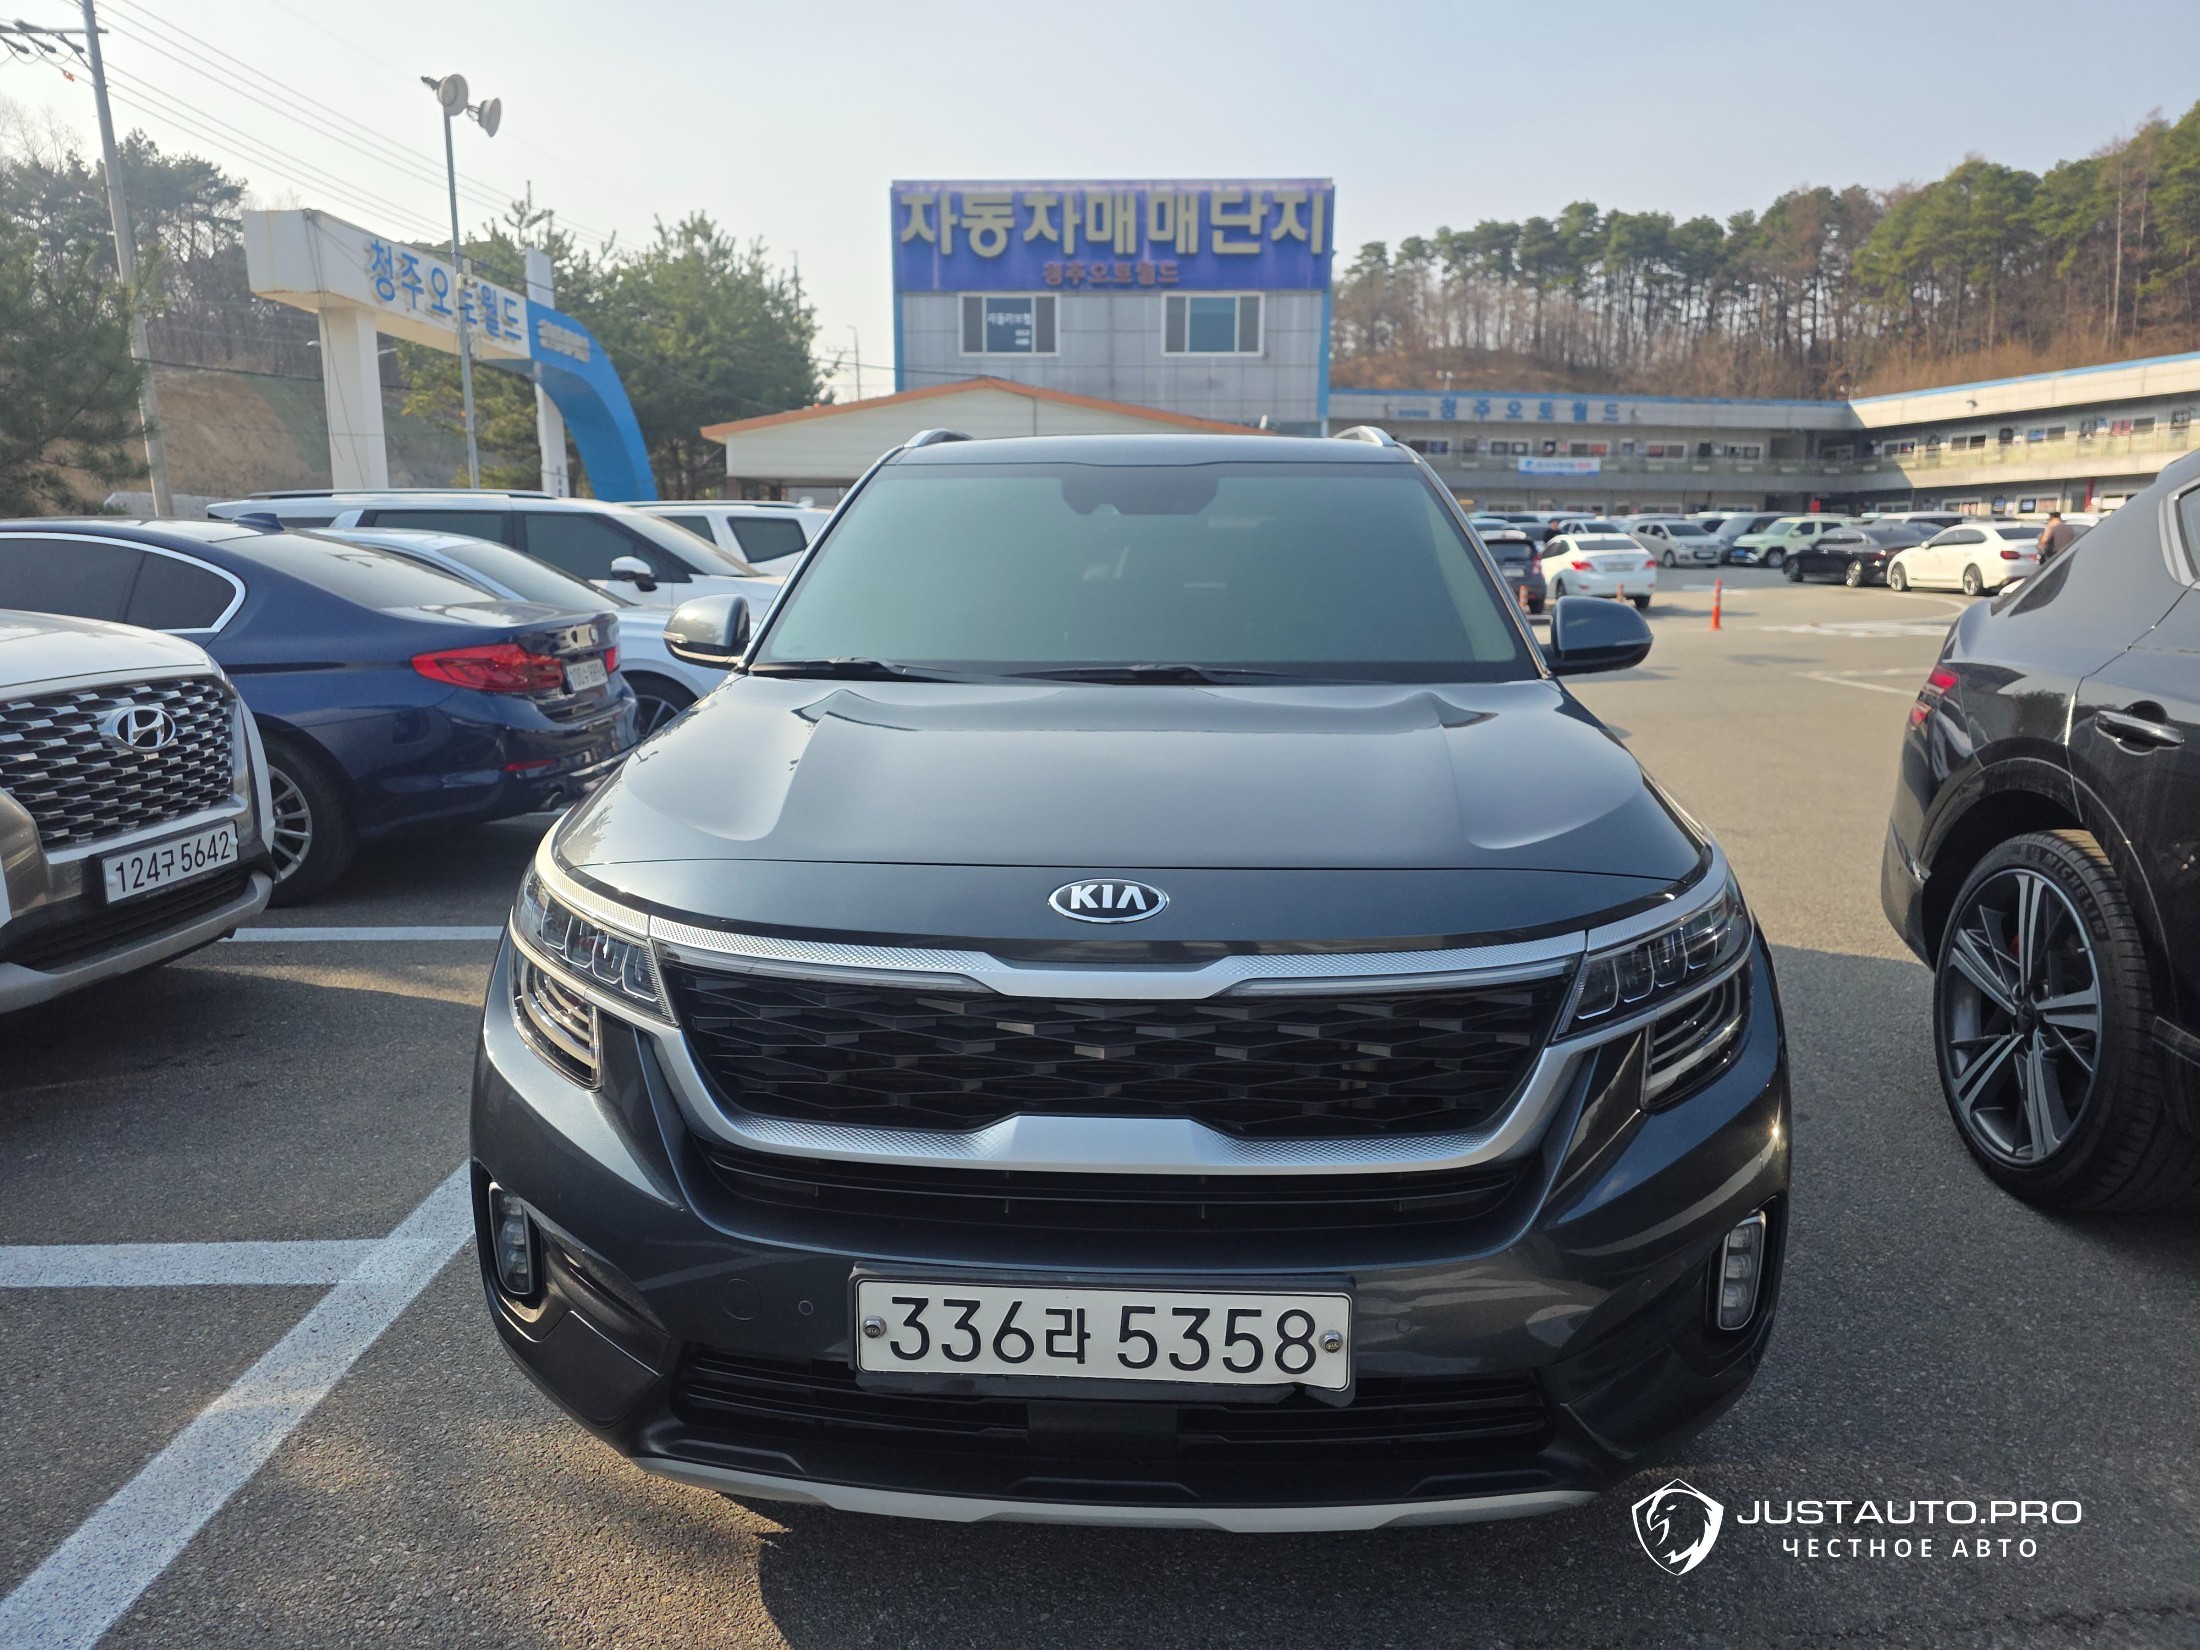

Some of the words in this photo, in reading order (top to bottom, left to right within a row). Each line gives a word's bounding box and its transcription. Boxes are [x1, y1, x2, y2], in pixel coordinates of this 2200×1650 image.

[900, 191, 1326, 257] 자동차매매단지
[115, 848, 176, 893] 124구
[181, 830, 231, 872] 5642
[2045, 852, 2107, 935] MICHELIN
[1070, 884, 1147, 910] KIA
[889, 1295, 1092, 1365] 336라
[1116, 1305, 1318, 1375] 5358
